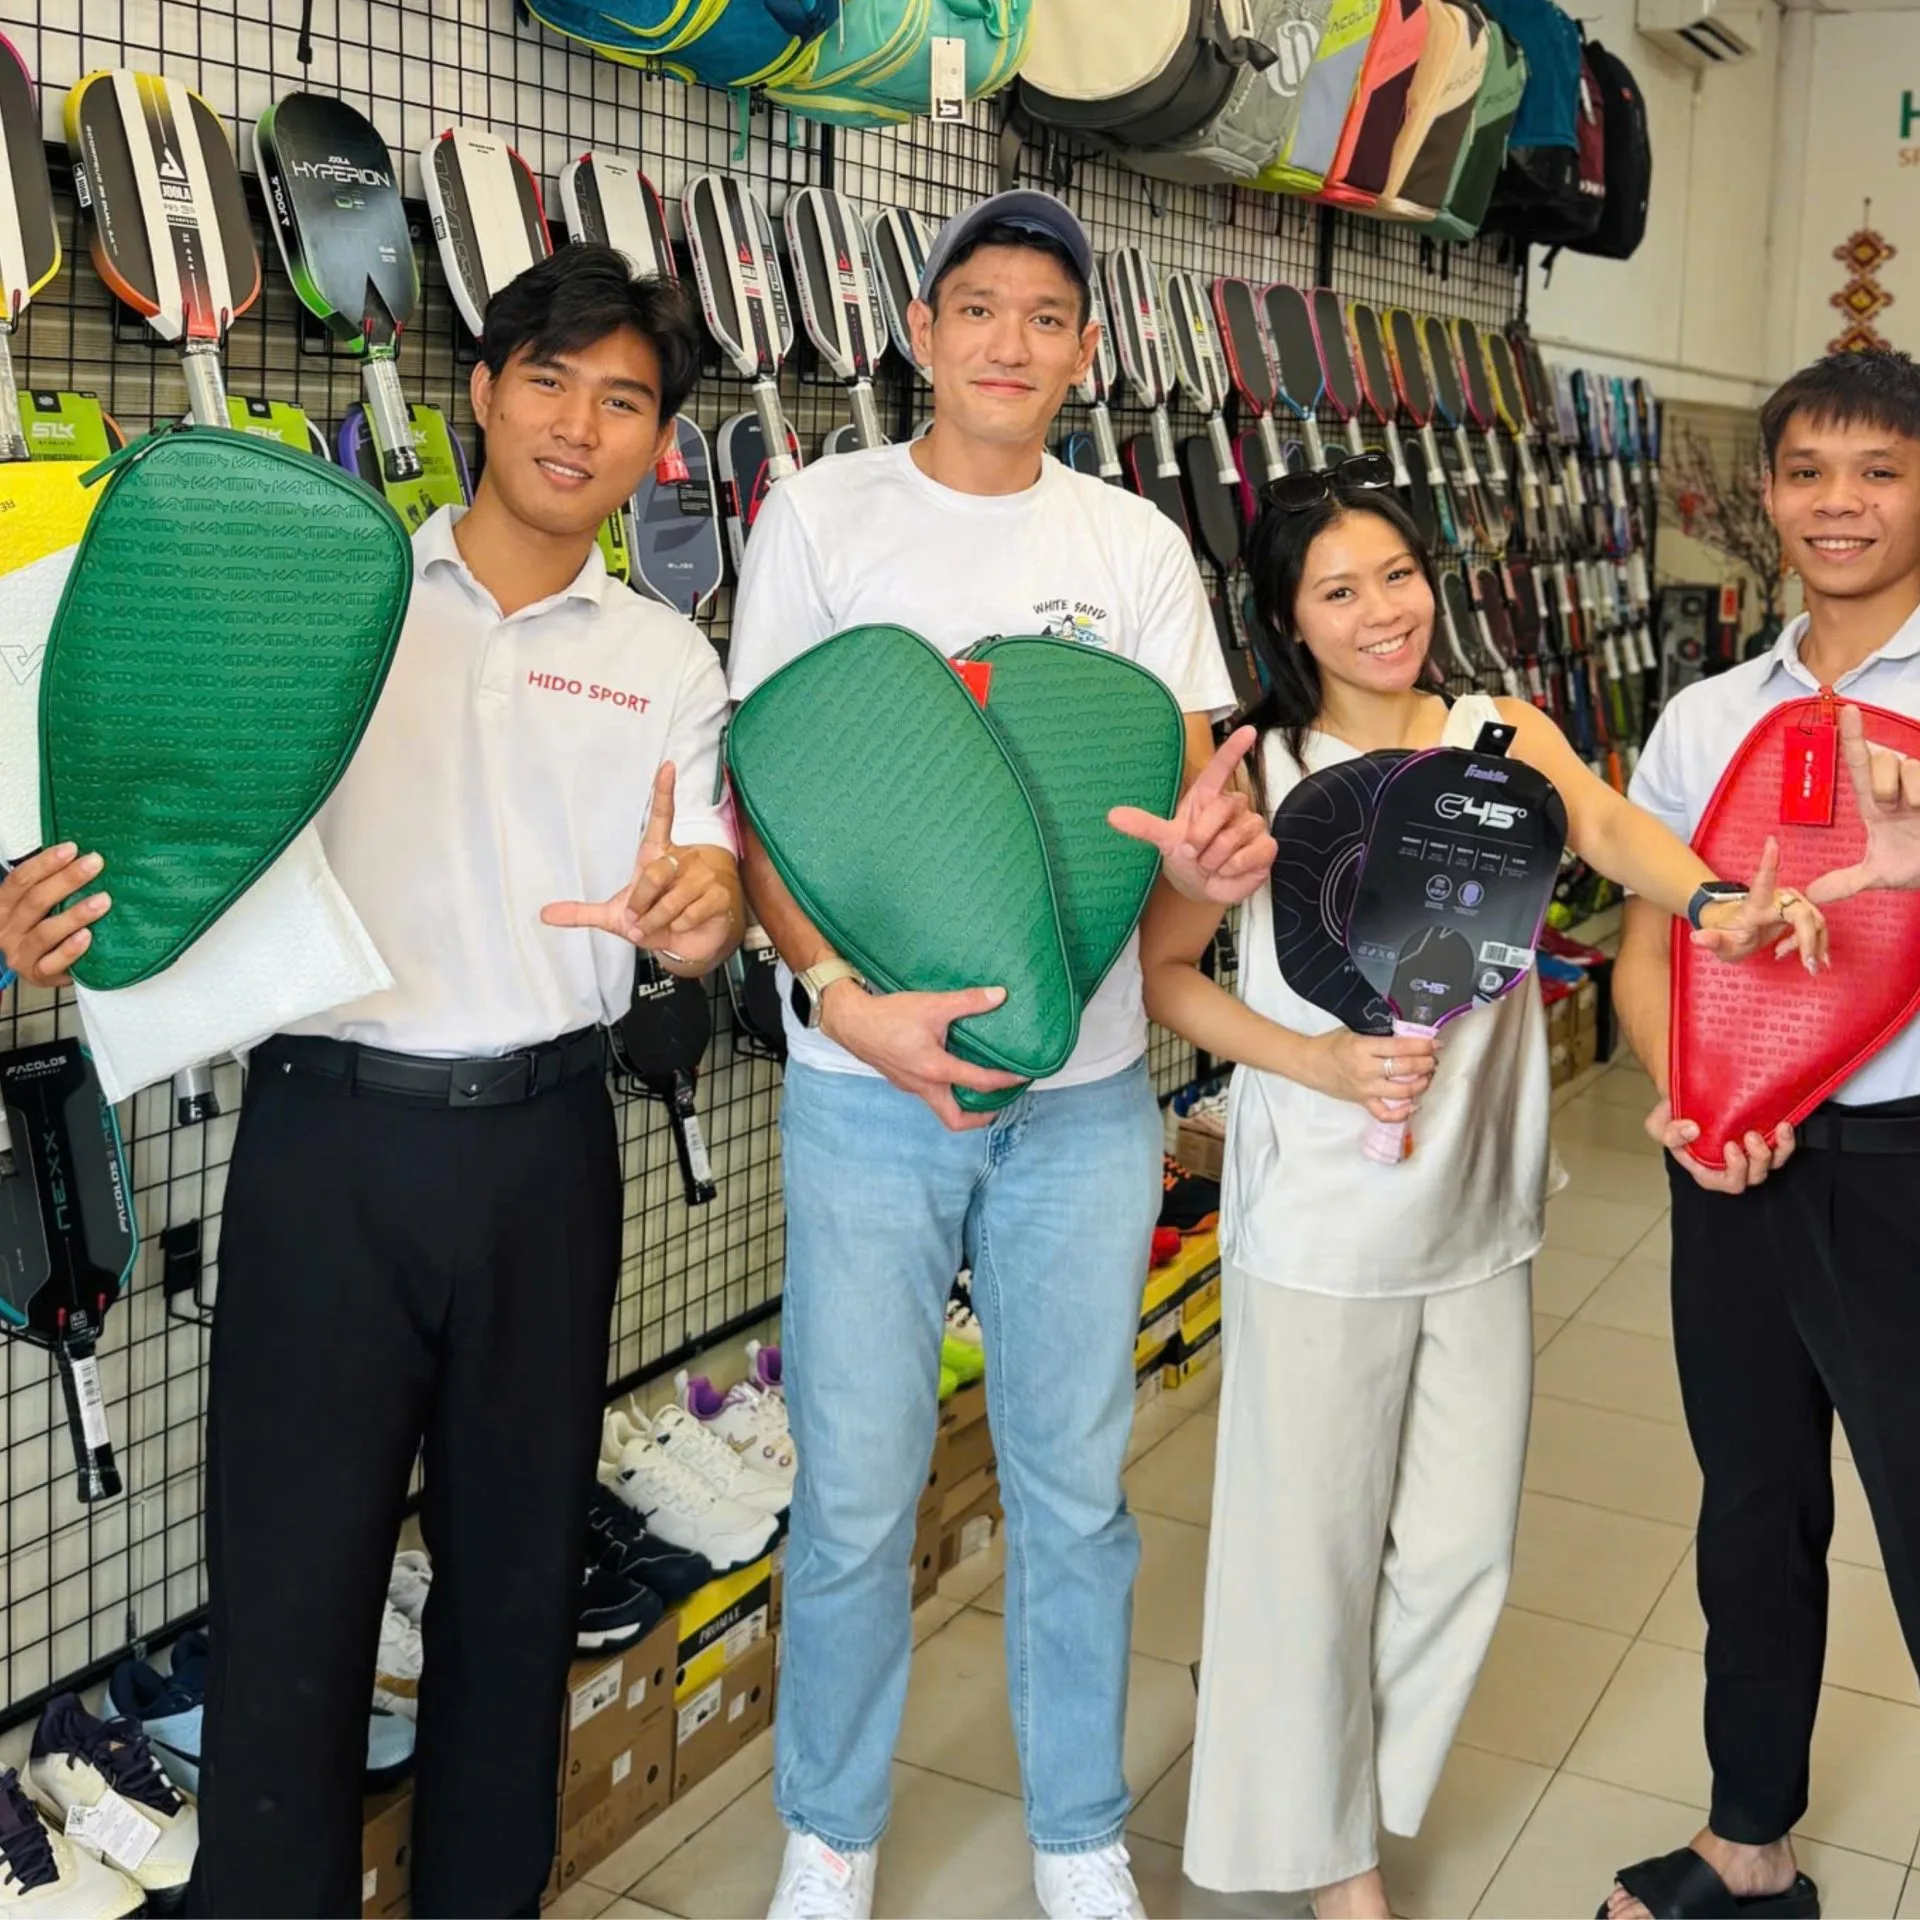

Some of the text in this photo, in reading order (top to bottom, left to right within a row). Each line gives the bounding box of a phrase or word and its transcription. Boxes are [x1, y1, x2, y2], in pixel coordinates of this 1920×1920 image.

[291, 160, 391, 187] HYPERION
[162, 183, 192, 201] JOOLA
[31, 422, 76, 440] SLK
[1032, 599, 1107, 620] WHITE SAND
[528, 670, 651, 714] HIDO SPORT
[1464, 763, 1510, 784] Franklin
[5, 1054, 68, 1077] FACOLOS
